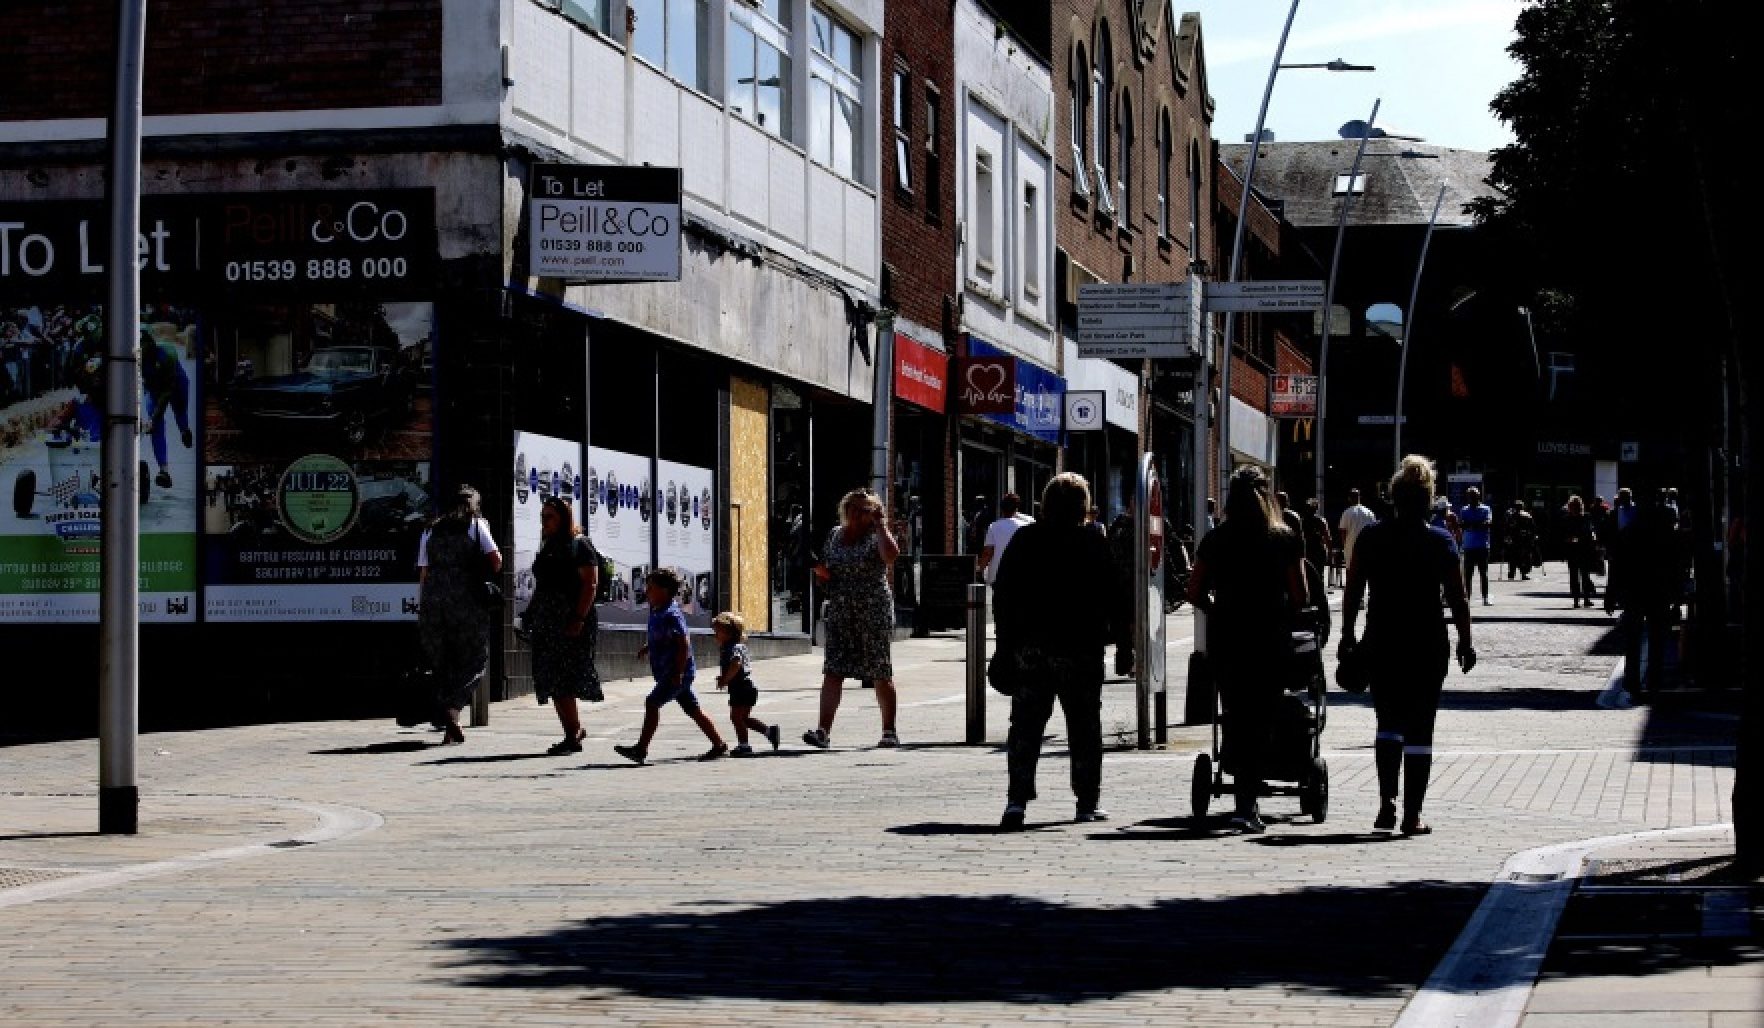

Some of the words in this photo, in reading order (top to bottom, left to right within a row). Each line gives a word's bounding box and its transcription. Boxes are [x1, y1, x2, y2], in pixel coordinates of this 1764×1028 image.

[542, 176, 563, 195] To
[573, 177, 605, 197] Let
[541, 204, 669, 237] Peill&Co
[0, 221, 54, 276] To
[540, 239, 581, 251] 01539
[587, 240, 613, 252] 888
[617, 241, 644, 253] 000
[225, 260, 296, 281] 01539
[307, 259, 351, 279] 888
[363, 257, 407, 278] 000
[287, 473, 325, 491] JUL
[328, 473, 349, 491] 22
